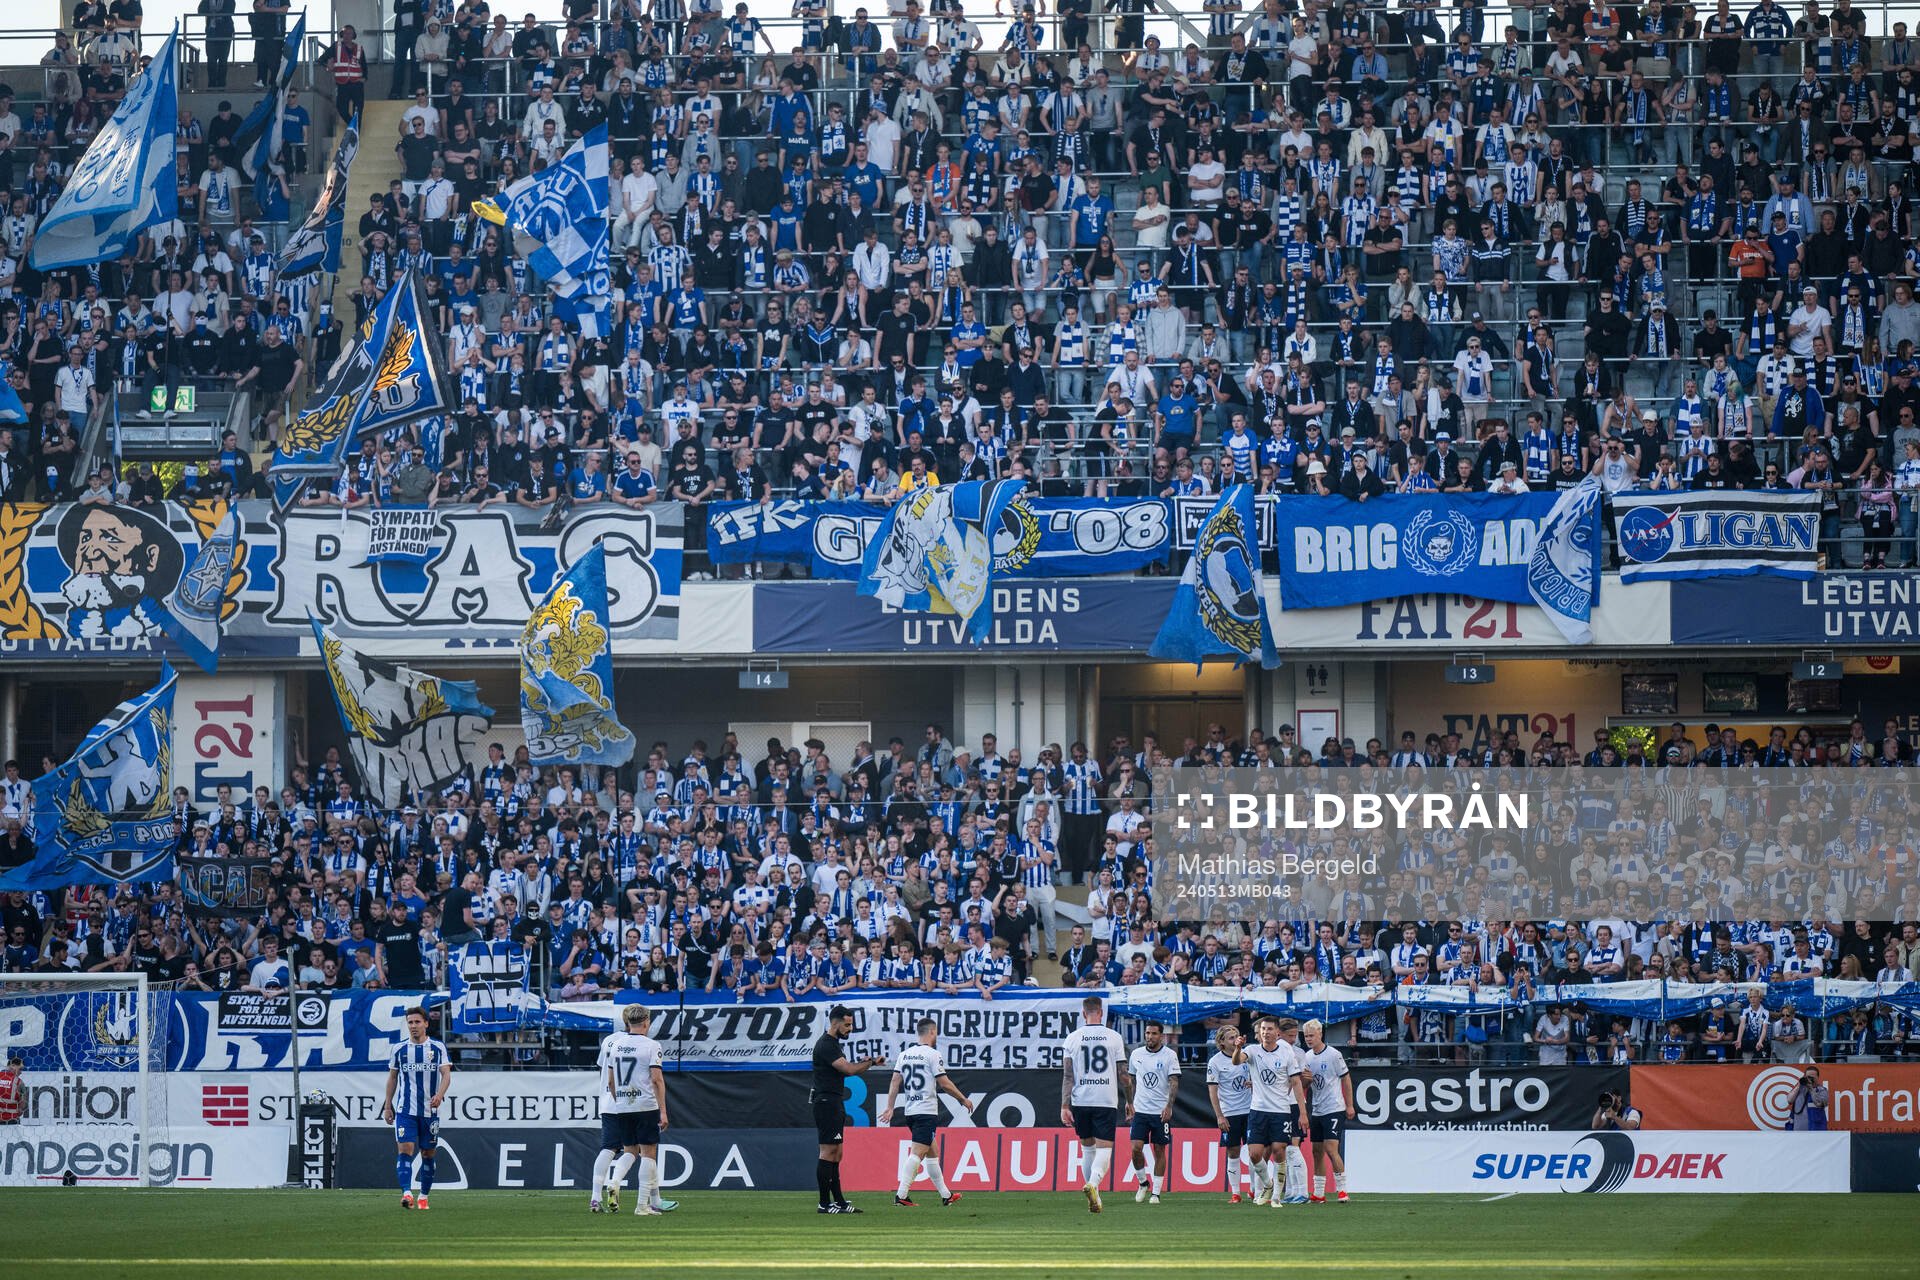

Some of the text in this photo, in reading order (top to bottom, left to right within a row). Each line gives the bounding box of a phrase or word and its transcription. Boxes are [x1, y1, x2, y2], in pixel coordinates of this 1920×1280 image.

[371, 511, 435, 525] SYMPATI
[1624, 511, 1818, 550] VASA LIGAN
[371, 524, 433, 541] FÖR DOM
[1294, 518, 1547, 573] BRIG AD
[265, 509, 658, 628] RAS
[882, 587, 1080, 613] LDENS
[1802, 579, 1920, 605] LEGEN
[1825, 610, 1920, 636] UTVA
[757, 675, 771, 686] 14
[1463, 668, 1477, 679] 13
[1811, 664, 1825, 676] 12
[262, 1006, 277, 1014] DE
[947, 1044, 992, 1068] 024
[1003, 1045, 1027, 1068] 15
[1081, 1045, 1108, 1074] 18
[615, 1056, 637, 1086] 17
[902, 1064, 925, 1091] 25
[1356, 1067, 1550, 1125] gastro
[1822, 1078, 1920, 1122] Infra
[1331, 1118, 1339, 1130] 7
[1472, 1153, 1728, 1180] SUPER DAEK
